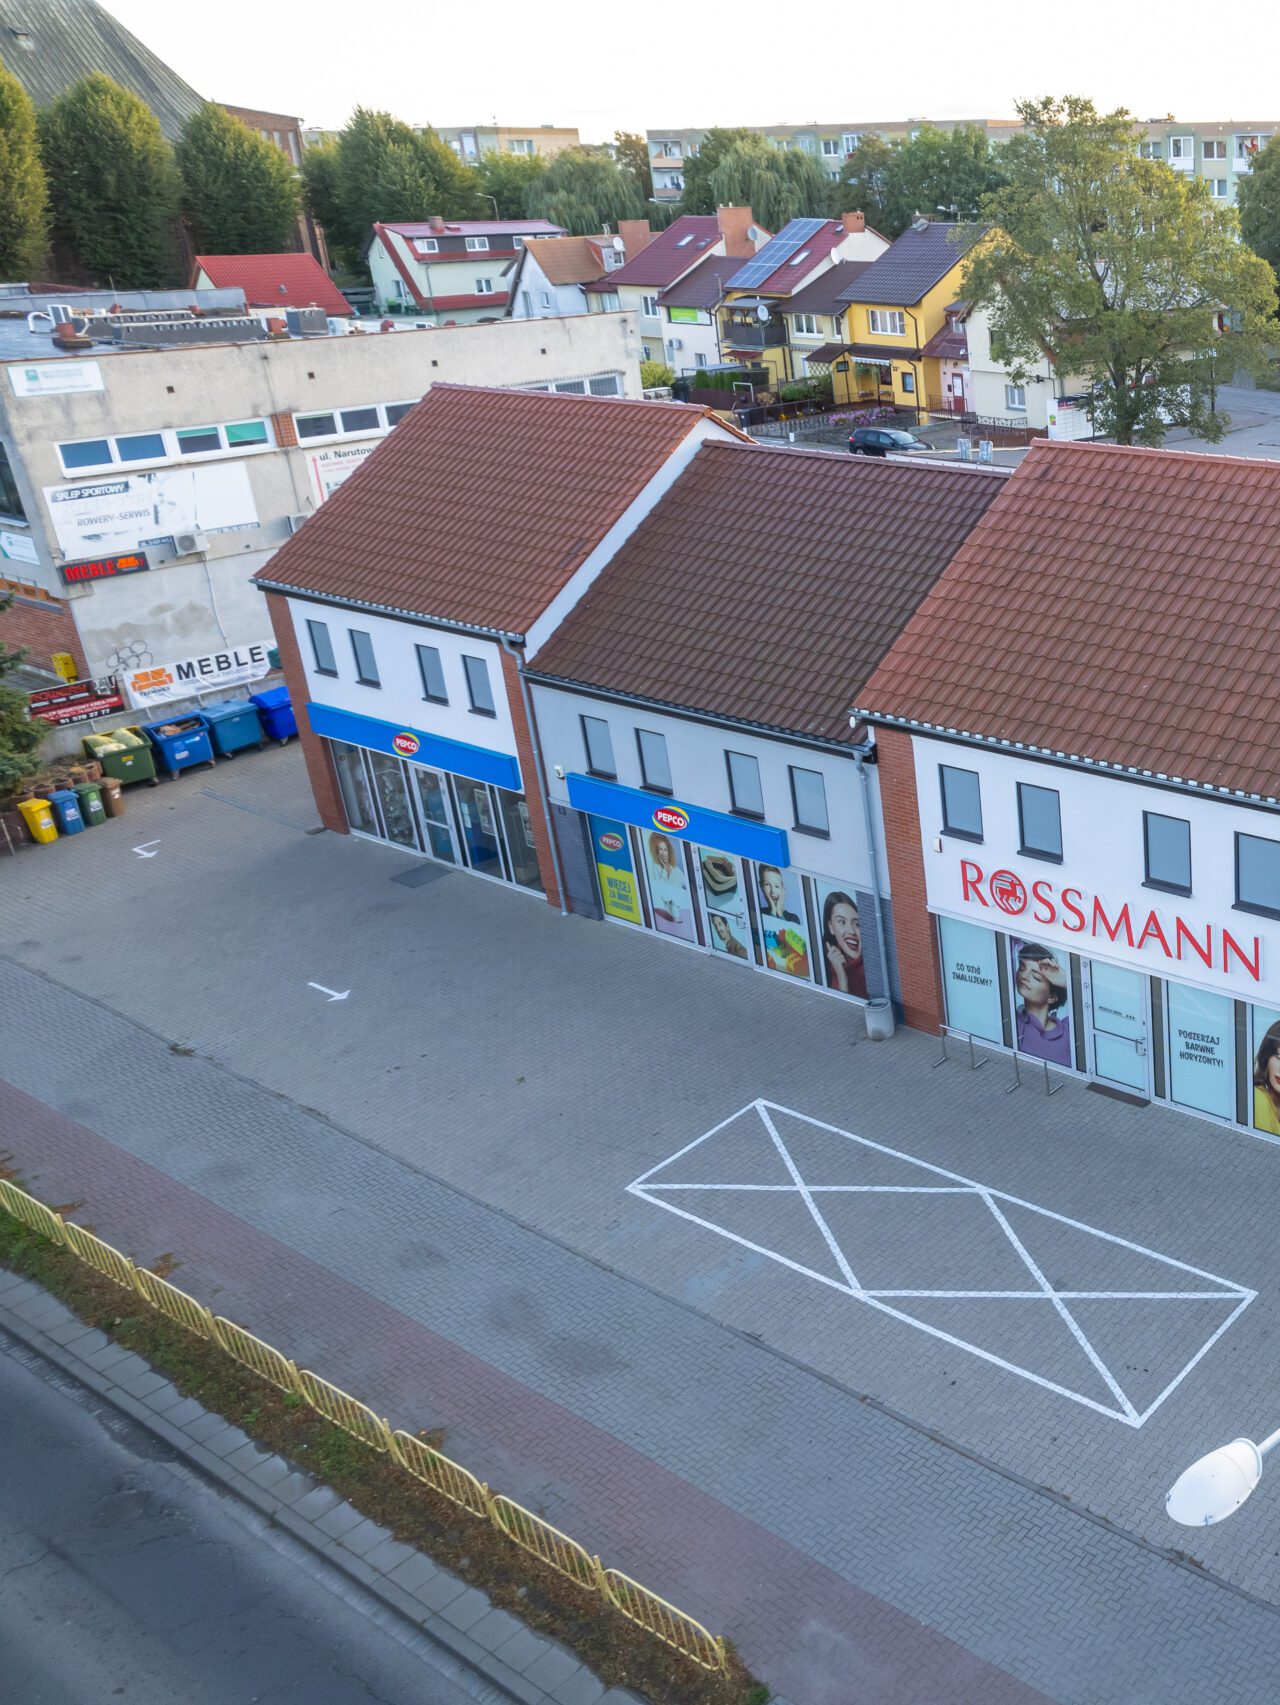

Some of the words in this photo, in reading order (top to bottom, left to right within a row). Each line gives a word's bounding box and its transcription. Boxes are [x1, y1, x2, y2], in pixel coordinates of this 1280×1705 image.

[319, 453, 331, 461] ul.
[334, 446, 376, 458] Narutow
[55, 490, 80, 501] SKLEP
[81, 483, 125, 498] SPORTOWY
[64, 559, 117, 582] MEBLE
[175, 645, 265, 680] MEBLE
[395, 738, 417, 751] PEPCO
[657, 811, 685, 827] PEPCO
[602, 836, 620, 848] PEPCO
[960, 859, 1260, 982] ROSSMANN
[956, 962, 965, 971] CO
[952, 971, 993, 987] ZMALUJEMY?
[1178, 1029, 1221, 1046] POSZERZAJ
[1185, 1041, 1216, 1055] BARWNE
[1179, 1051, 1224, 1068] HORYZONTY!
